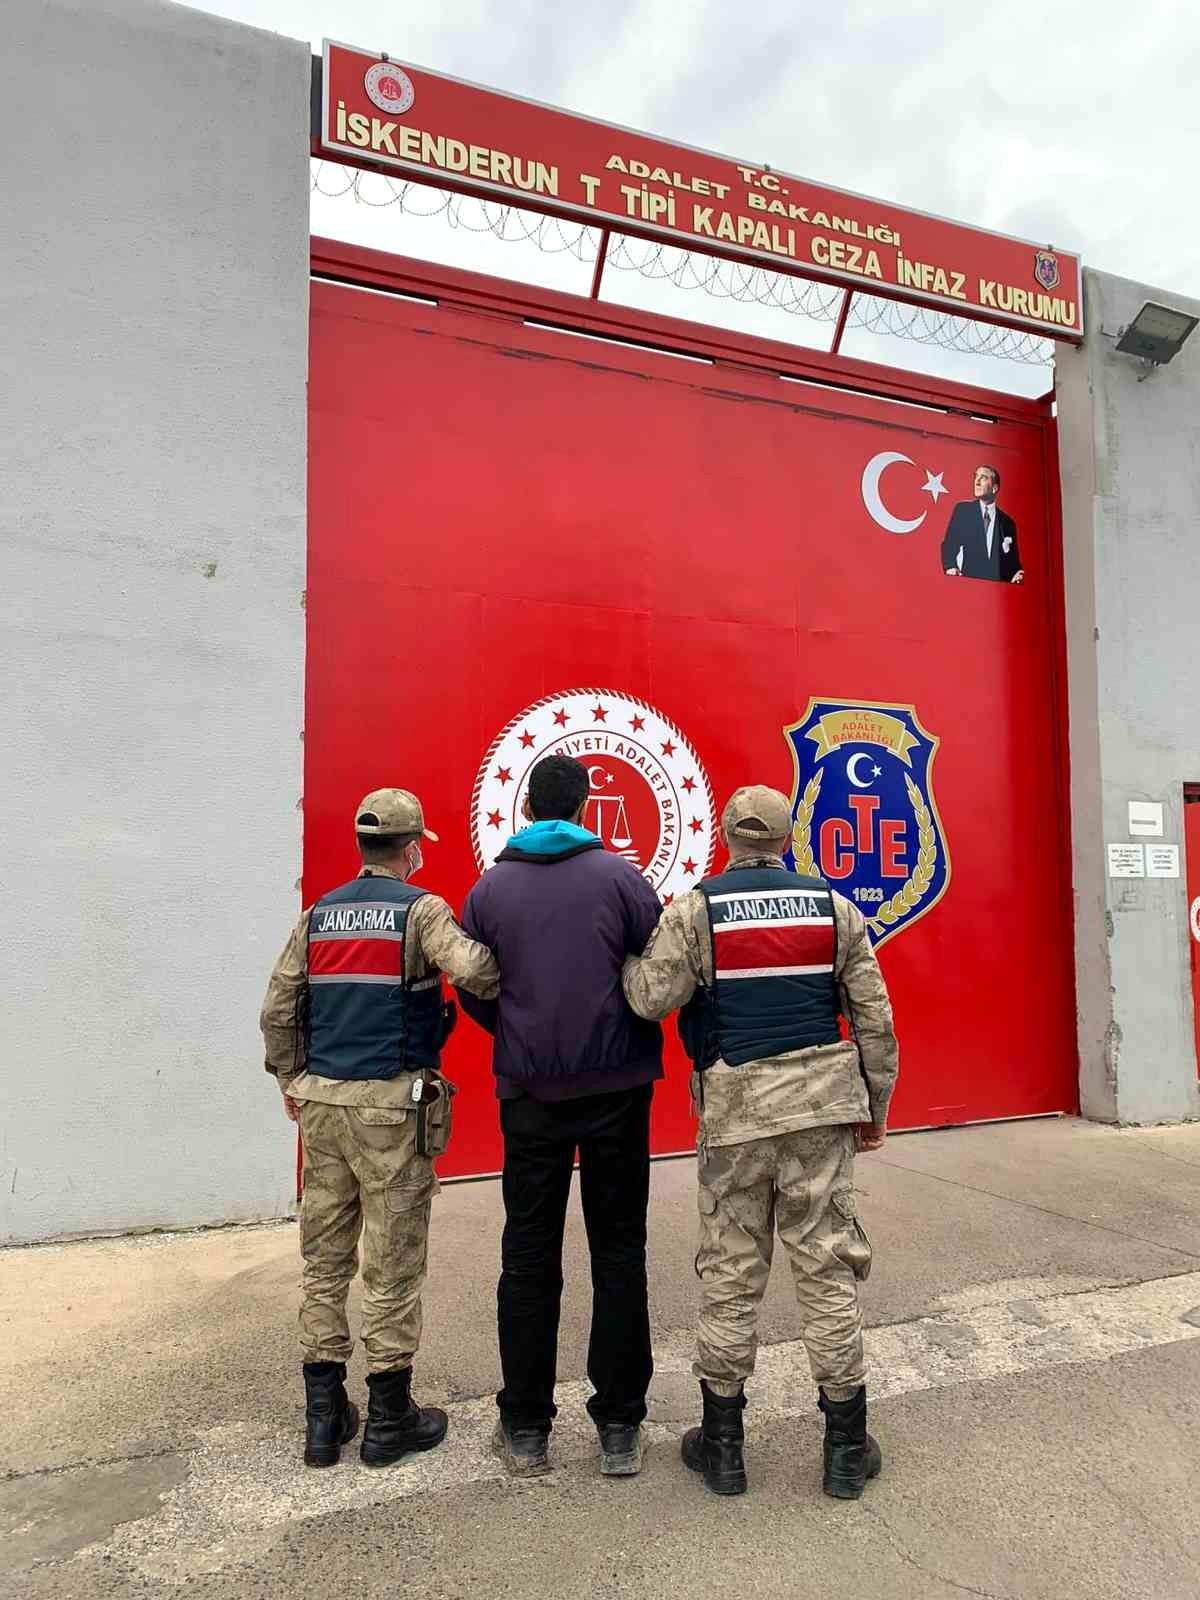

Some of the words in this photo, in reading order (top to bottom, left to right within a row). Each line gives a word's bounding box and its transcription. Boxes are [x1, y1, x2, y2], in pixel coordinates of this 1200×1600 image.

[737, 165, 788, 195] T.C.
[336, 101, 559, 196] İSKENDERUN
[579, 174, 601, 206] T
[621, 183, 676, 226] TİPİ
[693, 204, 796, 257] KAPALI
[811, 236, 882, 278] CEZA
[896, 252, 967, 300] İNFAZ
[979, 279, 1076, 326] KURUMU
[605, 154, 730, 200] ADALET
[748, 191, 901, 247] BAKANLIĞI
[842, 722, 884, 733] ADALET
[615, 742, 667, 792] ADALET
[819, 794, 909, 879] CTE
[723, 896, 821, 922] JANDARMA
[853, 888, 884, 902] 1923
[319, 909, 395, 931] JANDARMA
